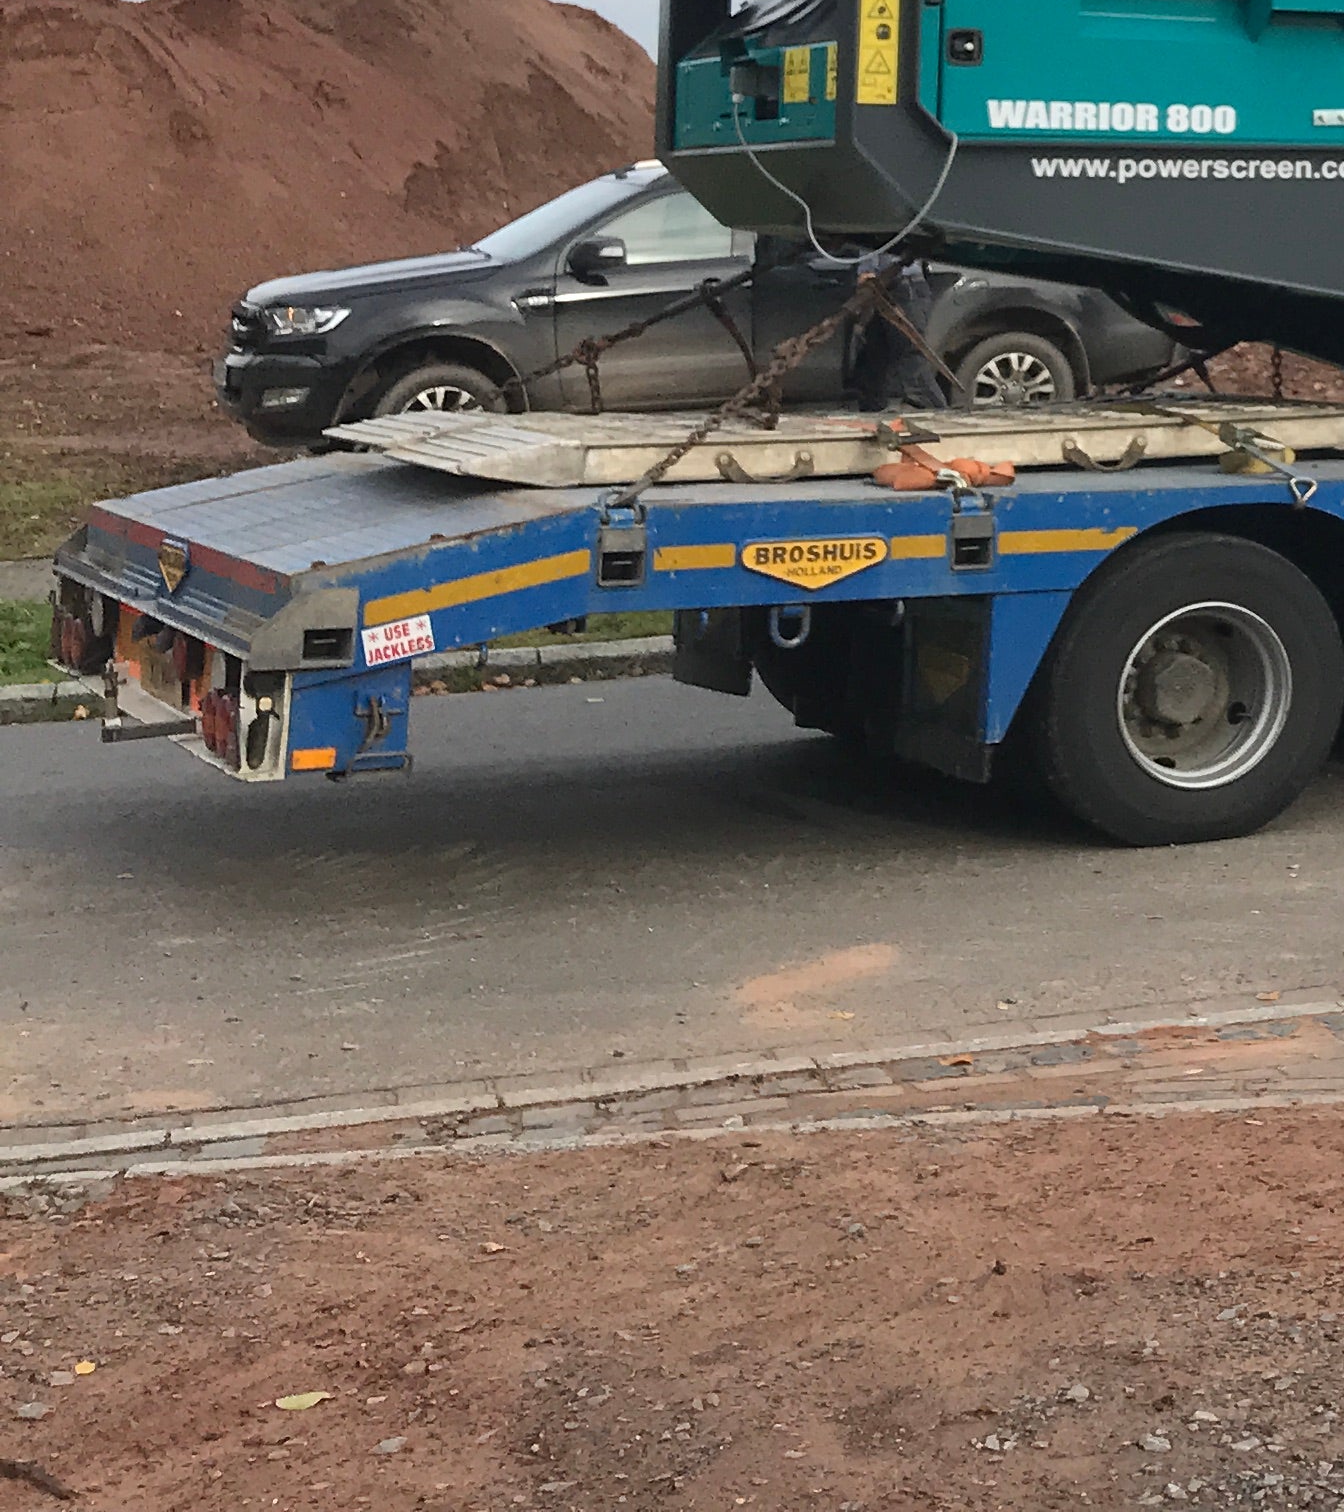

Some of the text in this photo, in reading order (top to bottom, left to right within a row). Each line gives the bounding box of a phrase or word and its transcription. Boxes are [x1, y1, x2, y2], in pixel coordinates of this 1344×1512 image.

[986, 99, 1237, 134] WARRIOR 800
[755, 542, 878, 566] BROSHUIS
[786, 565, 843, 577] HOLLAND
[383, 622, 411, 642] USE
[368, 634, 434, 665] JACKLEGS
